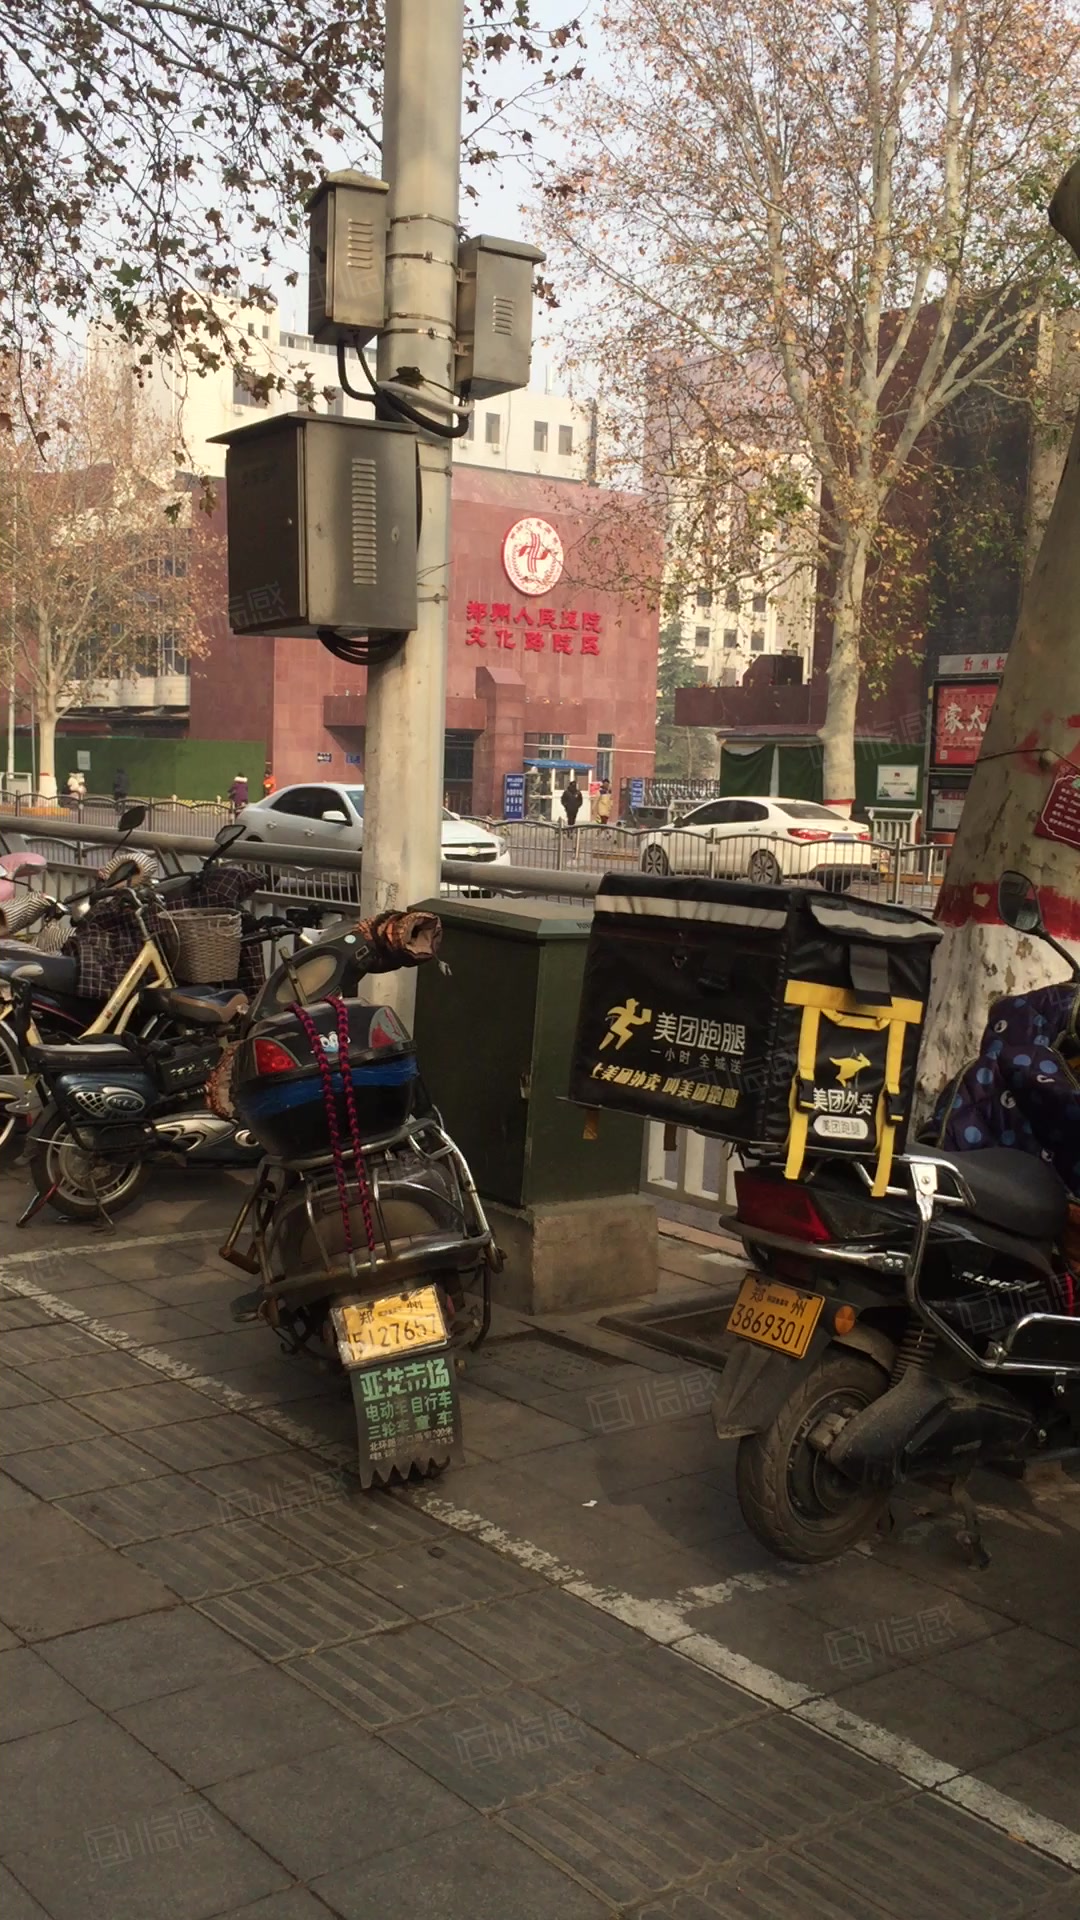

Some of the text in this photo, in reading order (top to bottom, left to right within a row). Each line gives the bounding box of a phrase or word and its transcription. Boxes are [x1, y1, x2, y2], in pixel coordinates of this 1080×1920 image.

[466, 601, 602, 633] 郑州人民医院
[465, 626, 600, 656] 文化路院区
[653, 1011, 747, 1056] 美团跑腿
[650, 1047, 691, 1066] 一小时
[812, 1087, 874, 1116] 美团外卖
[731, 1303, 805, 1349] 3869301
[410, 1390, 453, 1414] 自行车
[367, 1418, 410, 1440] 三轮车
